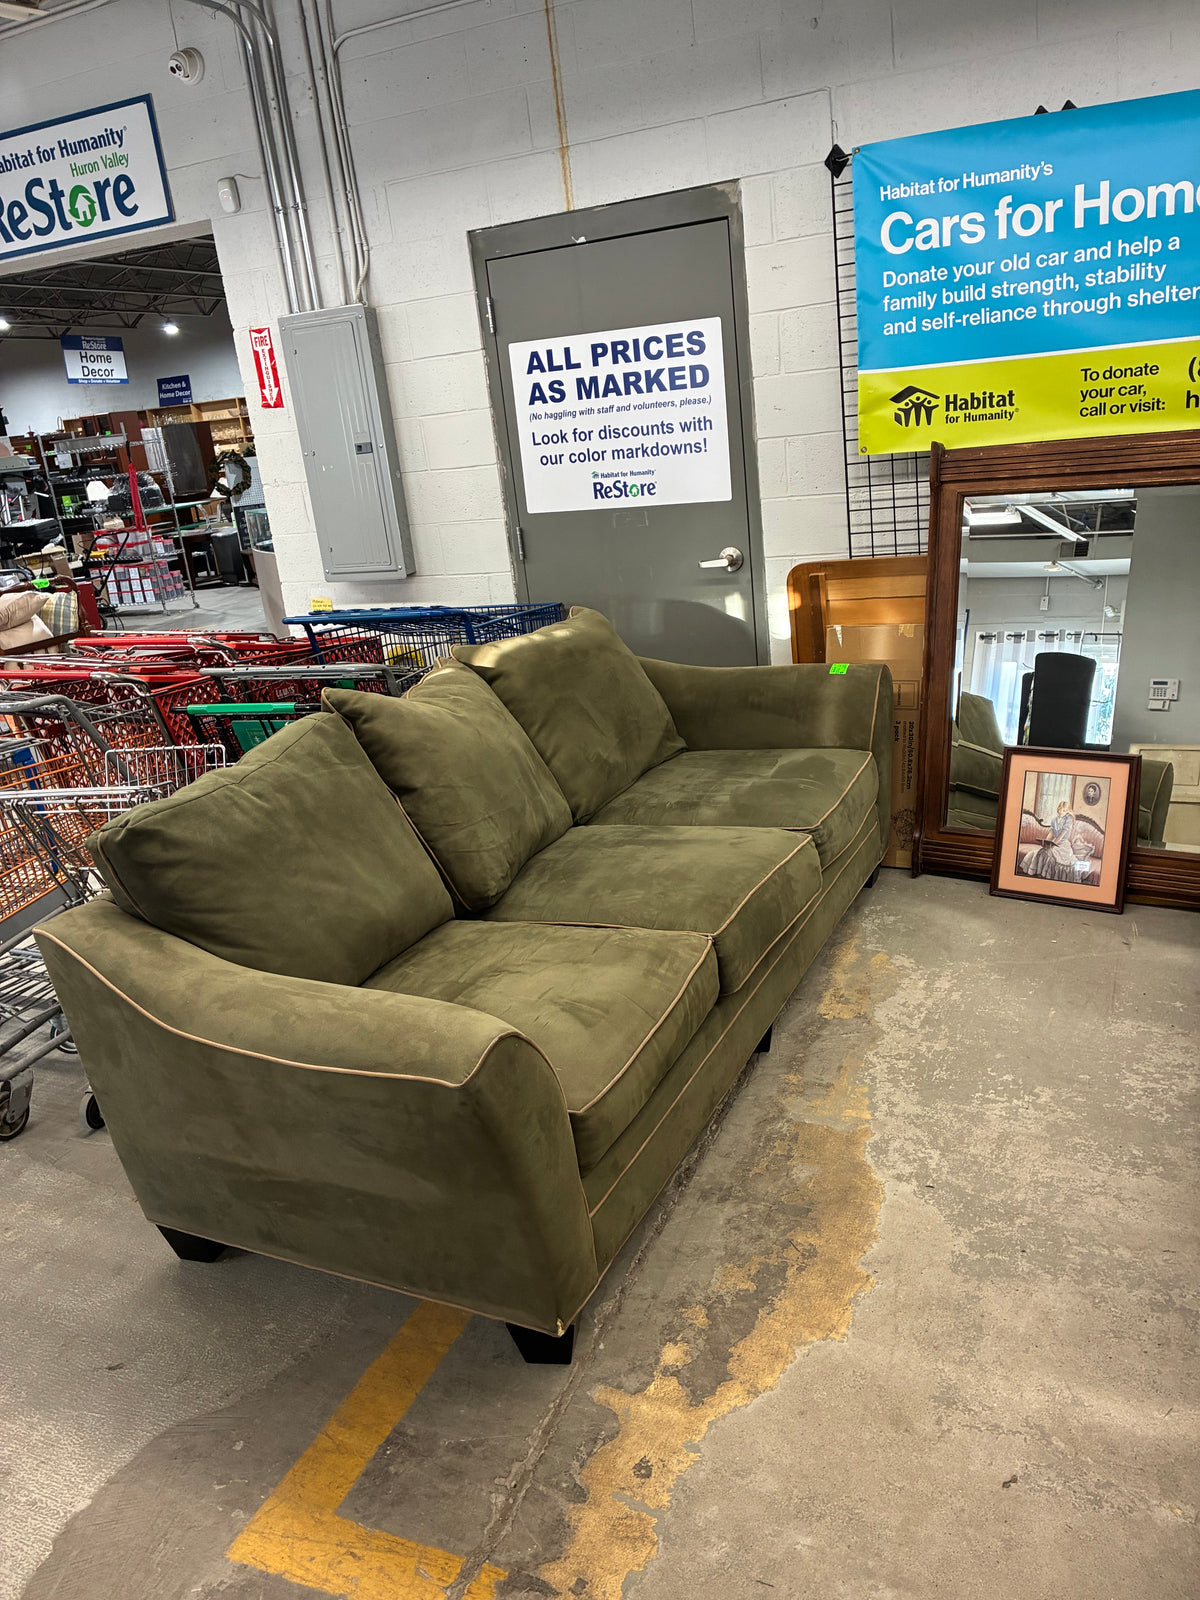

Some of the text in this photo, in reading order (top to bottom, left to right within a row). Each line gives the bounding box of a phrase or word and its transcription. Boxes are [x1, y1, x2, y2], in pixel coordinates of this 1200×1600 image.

[36, 145, 56, 164] for
[57, 127, 124, 159] Humanity
[69, 152, 129, 177] Huron Valley
[880, 161, 1053, 201] Habitat for Humanity's
[880, 180, 1200, 255] Cars for Hom
[883, 235, 1180, 288] Donate your old car and help a
[883, 262, 1166, 312] family build strength, stability
[883, 316, 917, 336] and
[921, 305, 1037, 331] self-reliance
[1043, 292, 1121, 317] through
[253, 335, 269, 348] FIRE
[526, 331, 706, 375] ALL PRICES
[79, 351, 112, 364] Home
[81, 365, 114, 378] Decor
[261, 348, 274, 402] EXTINGUISHER
[528, 364, 710, 405] AS MARKED
[1080, 363, 1159, 382] To donate
[161, 380, 187, 390] Kitchen &
[1080, 384, 1147, 402] your car,
[529, 395, 712, 422] (No haggling with staff and volunteers, please.)
[945, 390, 1015, 412] Habitat
[1079, 398, 1166, 417] call or visit:
[945, 410, 1015, 424] for Humanity
[532, 415, 713, 446] Look for discounts with
[540, 438, 708, 466] our color markdowns!
[600, 471, 620, 479] Habitat
[629, 469, 655, 477] Humanity
[593, 480, 657, 499] ReStore
